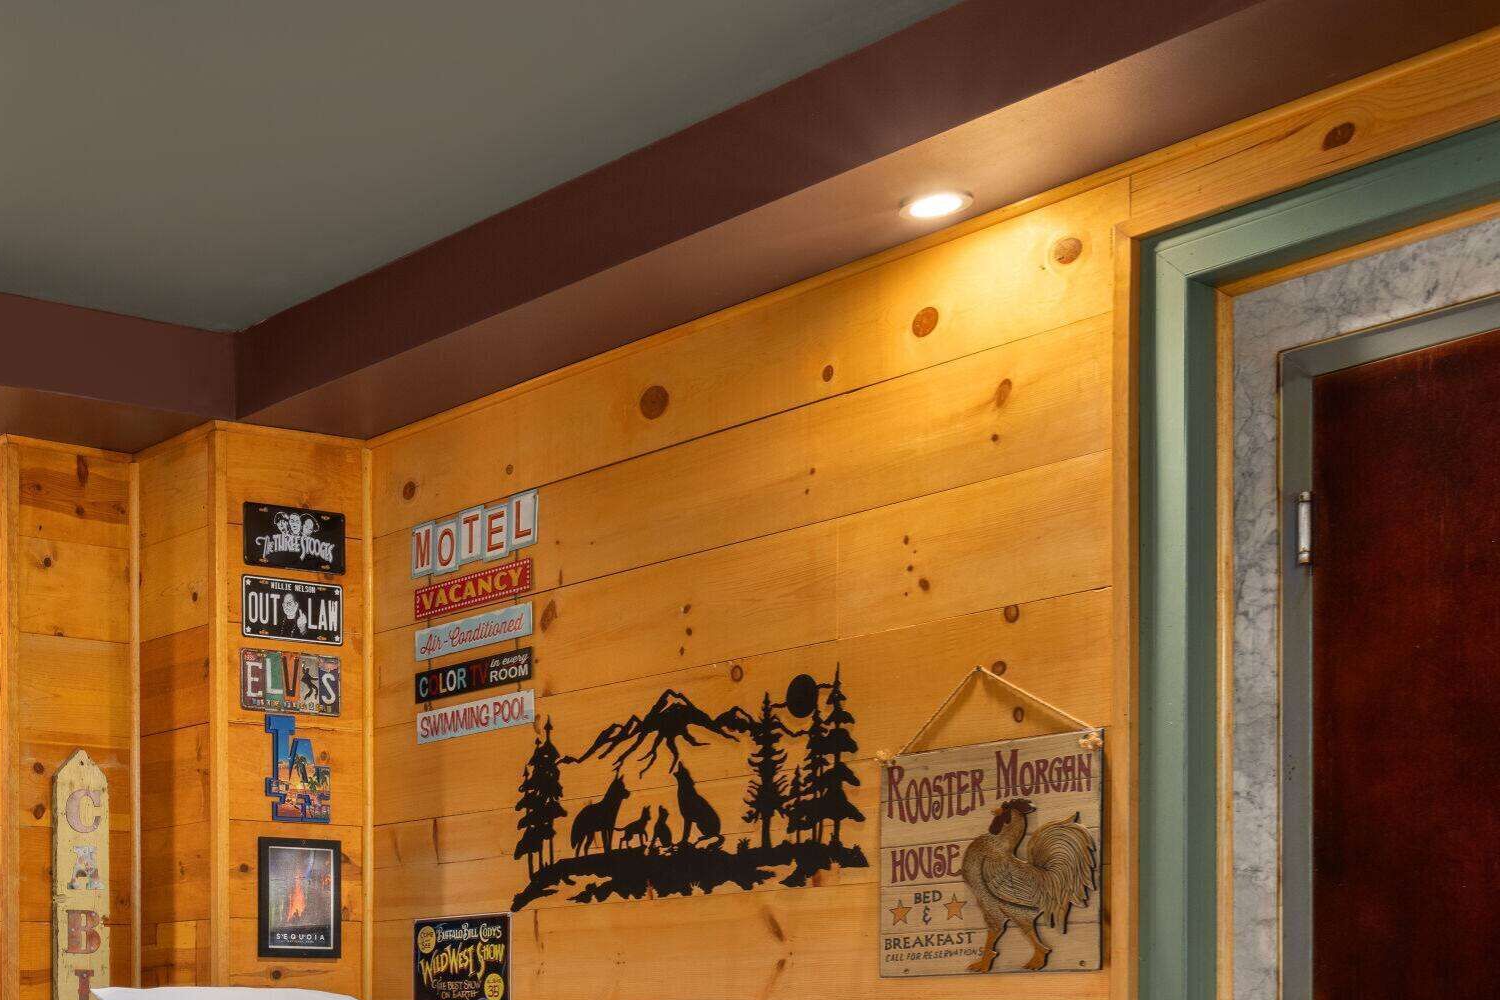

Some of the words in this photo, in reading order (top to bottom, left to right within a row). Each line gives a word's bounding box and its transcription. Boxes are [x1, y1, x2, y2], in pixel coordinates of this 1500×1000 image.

[416, 500, 531, 570] MOTEL
[270, 581, 293, 591] WILLIE
[294, 584, 316, 594] NELSON
[421, 567, 524, 611] VACANCY
[248, 591, 280, 626] OUT
[307, 597, 338, 632] LAW
[246, 656, 336, 705] ELVS
[419, 667, 467, 698] COLOR
[470, 662, 488, 686] TV
[490, 664, 529, 683] ROOM
[420, 702, 490, 739] SWIMMING
[493, 697, 530, 725] POOL
[887, 765, 985, 824] ROOSTER
[995, 749, 1092, 800] MORGAN
[891, 844, 963, 884] HOUSE
[914, 890, 942, 904] BED
[276, 933, 325, 941] SEQUOIA
[884, 932, 976, 950] BREAKFAST
[907, 952, 921, 961] FOR
